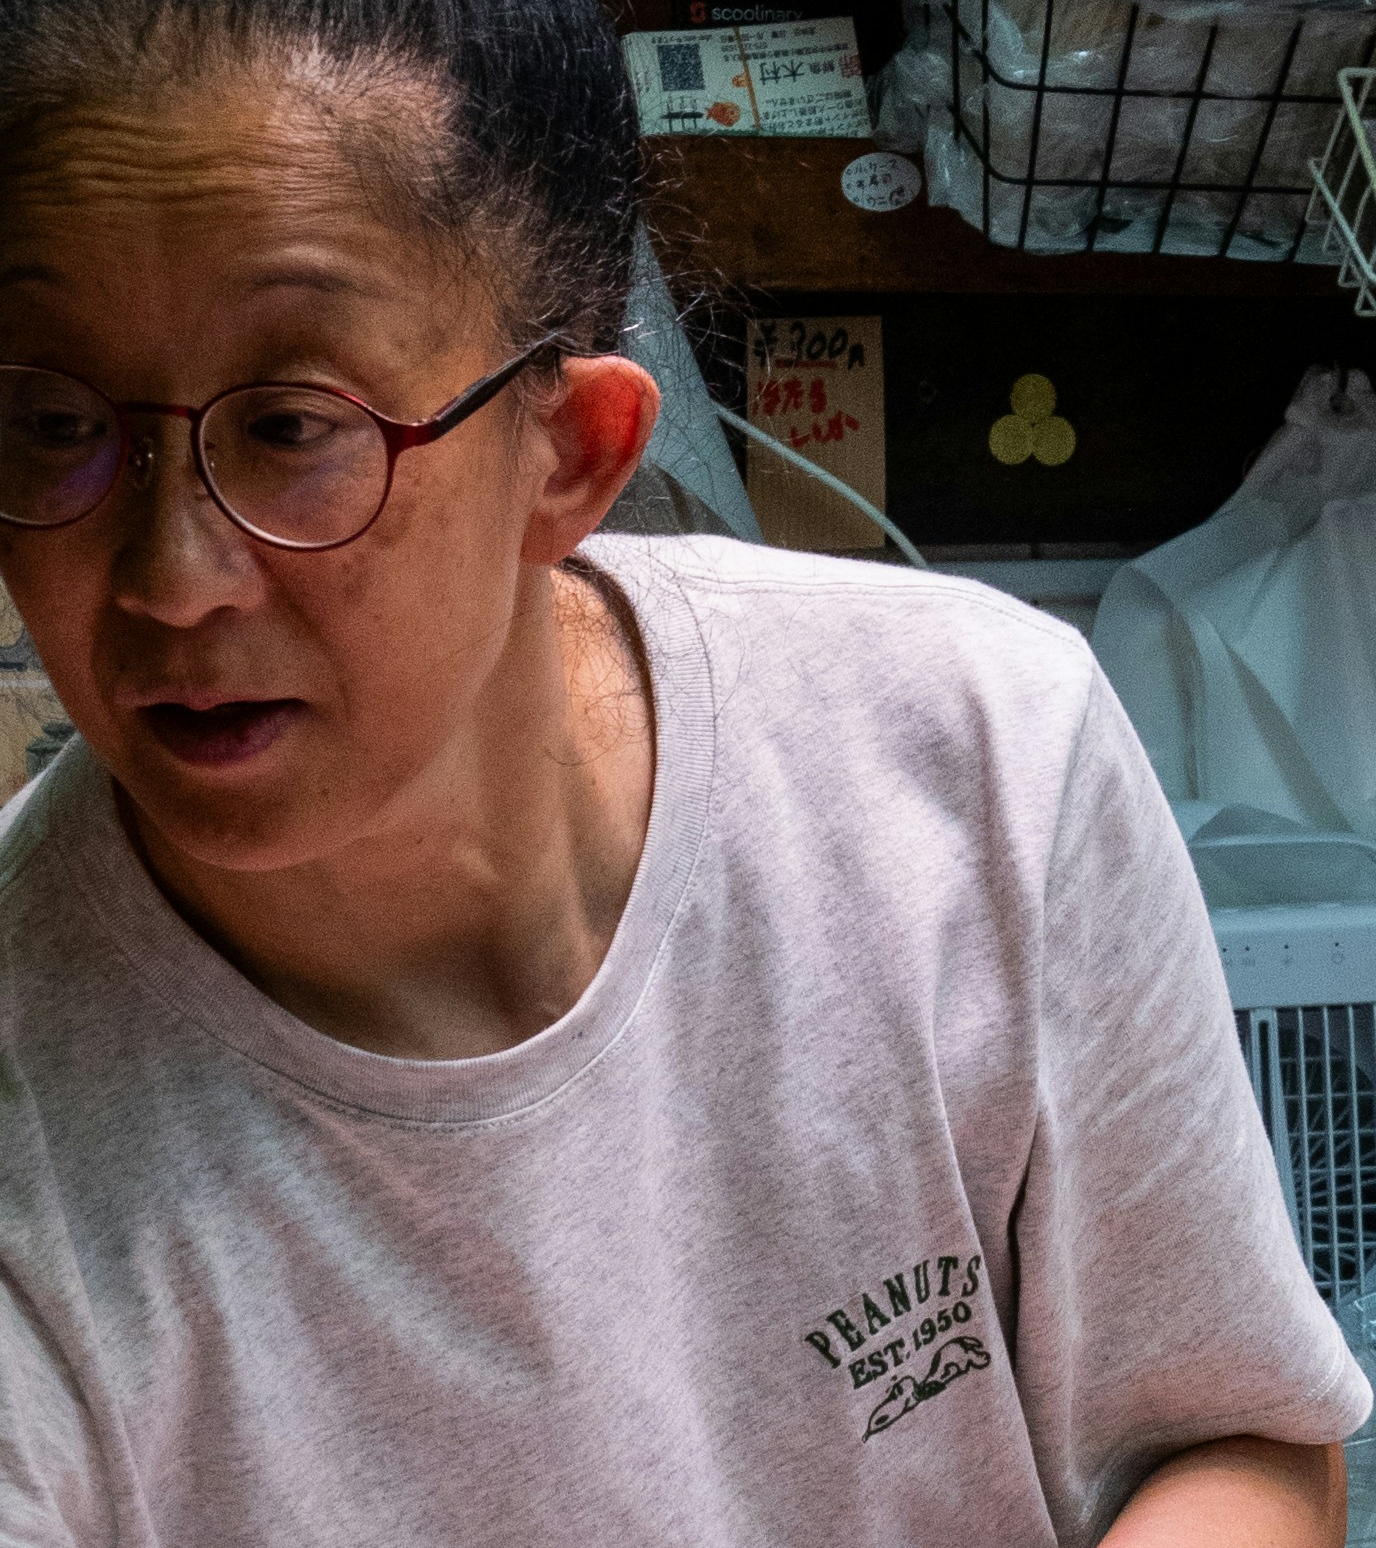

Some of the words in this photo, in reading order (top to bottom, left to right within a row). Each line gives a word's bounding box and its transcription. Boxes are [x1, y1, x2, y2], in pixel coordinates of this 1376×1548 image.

[711, 4, 804, 22] scoolinary
[759, 58, 805, 87] 木村
[803, 1254, 982, 1370] PEANUTS
[847, 1336, 911, 1391] EST.
[912, 1299, 973, 1352] 1950
